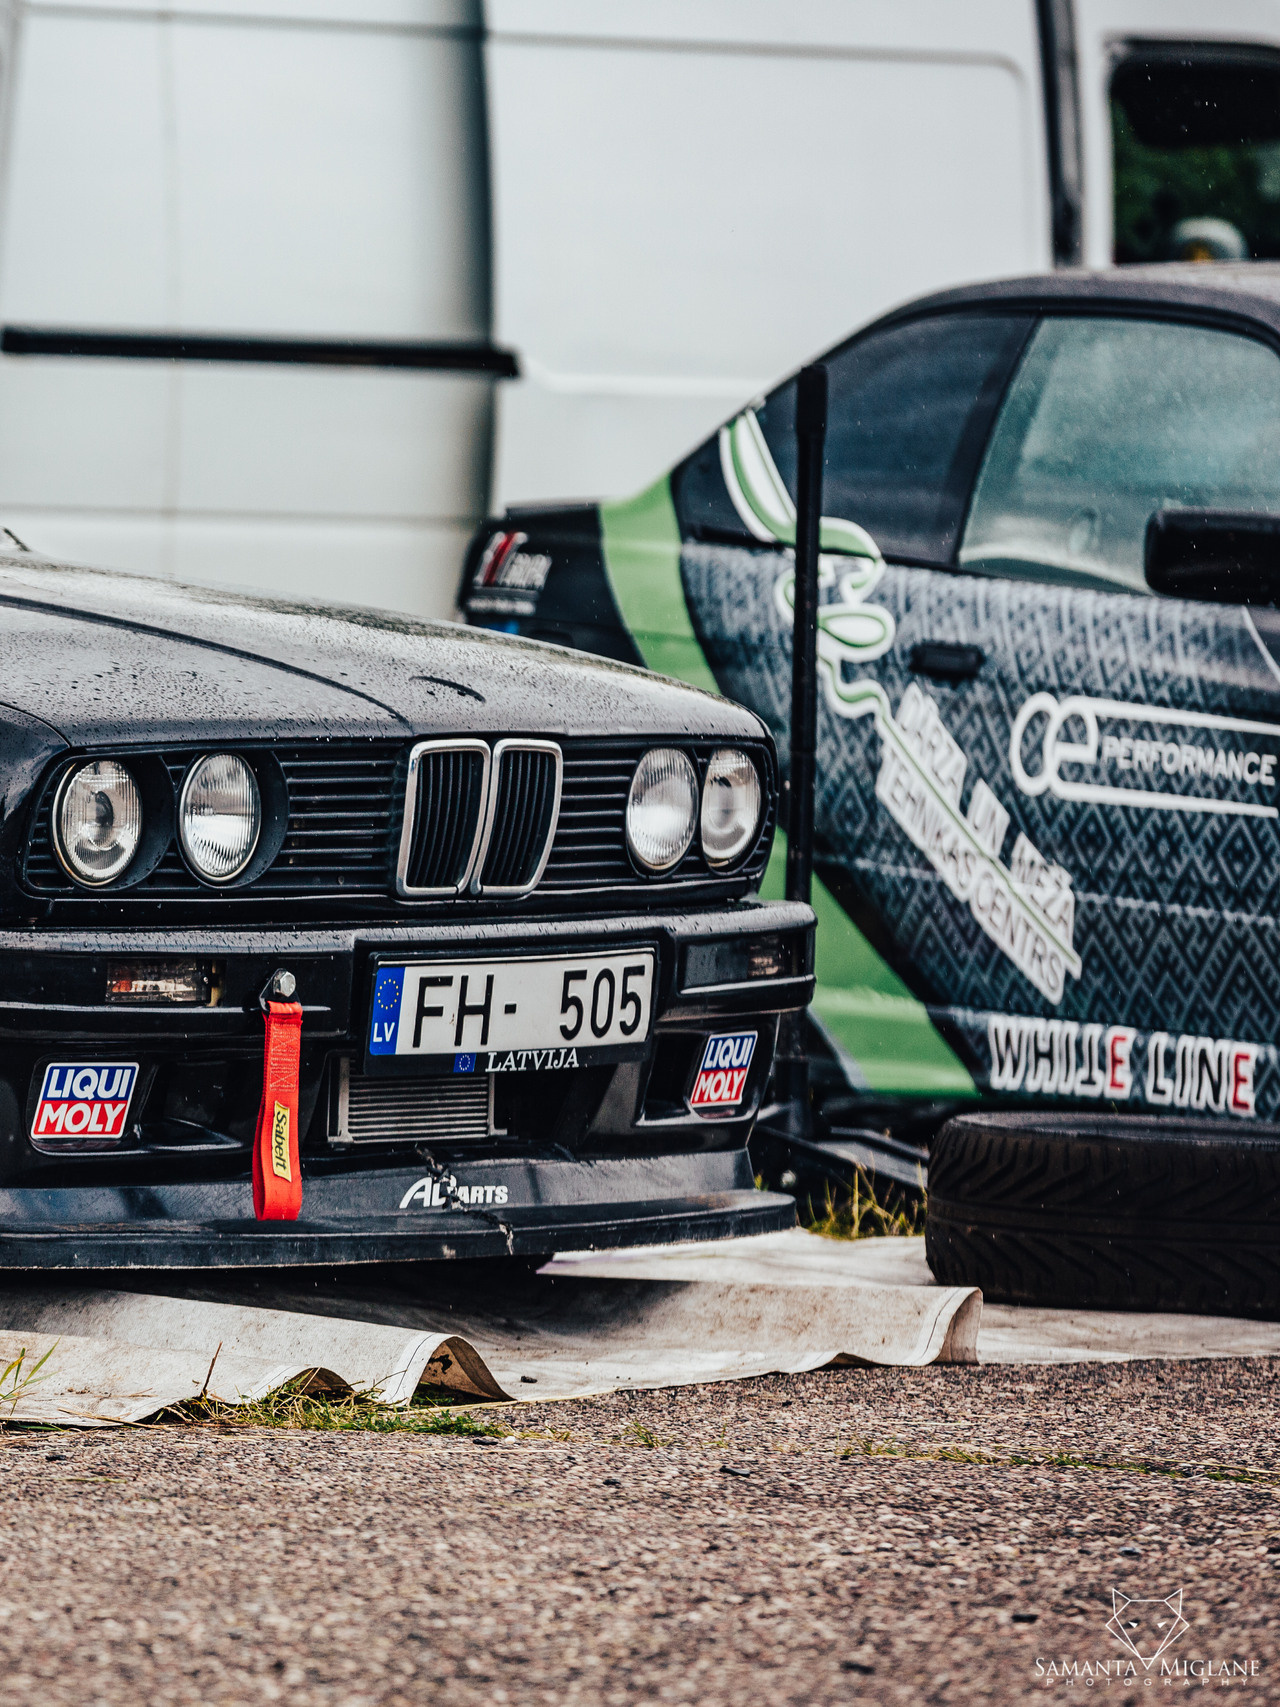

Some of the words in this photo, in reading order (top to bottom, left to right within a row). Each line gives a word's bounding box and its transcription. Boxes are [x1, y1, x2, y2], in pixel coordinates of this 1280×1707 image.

[1101, 735, 1278, 787] PERFORMANCE
[973, 870, 1063, 995] CENTRS
[558, 964, 646, 1041] 505
[372, 1022, 396, 1043] LV
[484, 1047, 580, 1073] LATVIJA
[703, 1037, 754, 1069] LIQUI
[46, 1068, 133, 1100] LIQUI
[693, 1070, 746, 1102] MOLY
[1149, 1036, 1255, 1114] LINE
[37, 1102, 127, 1134] MOLY
[275, 1110, 289, 1171] Sabelt
